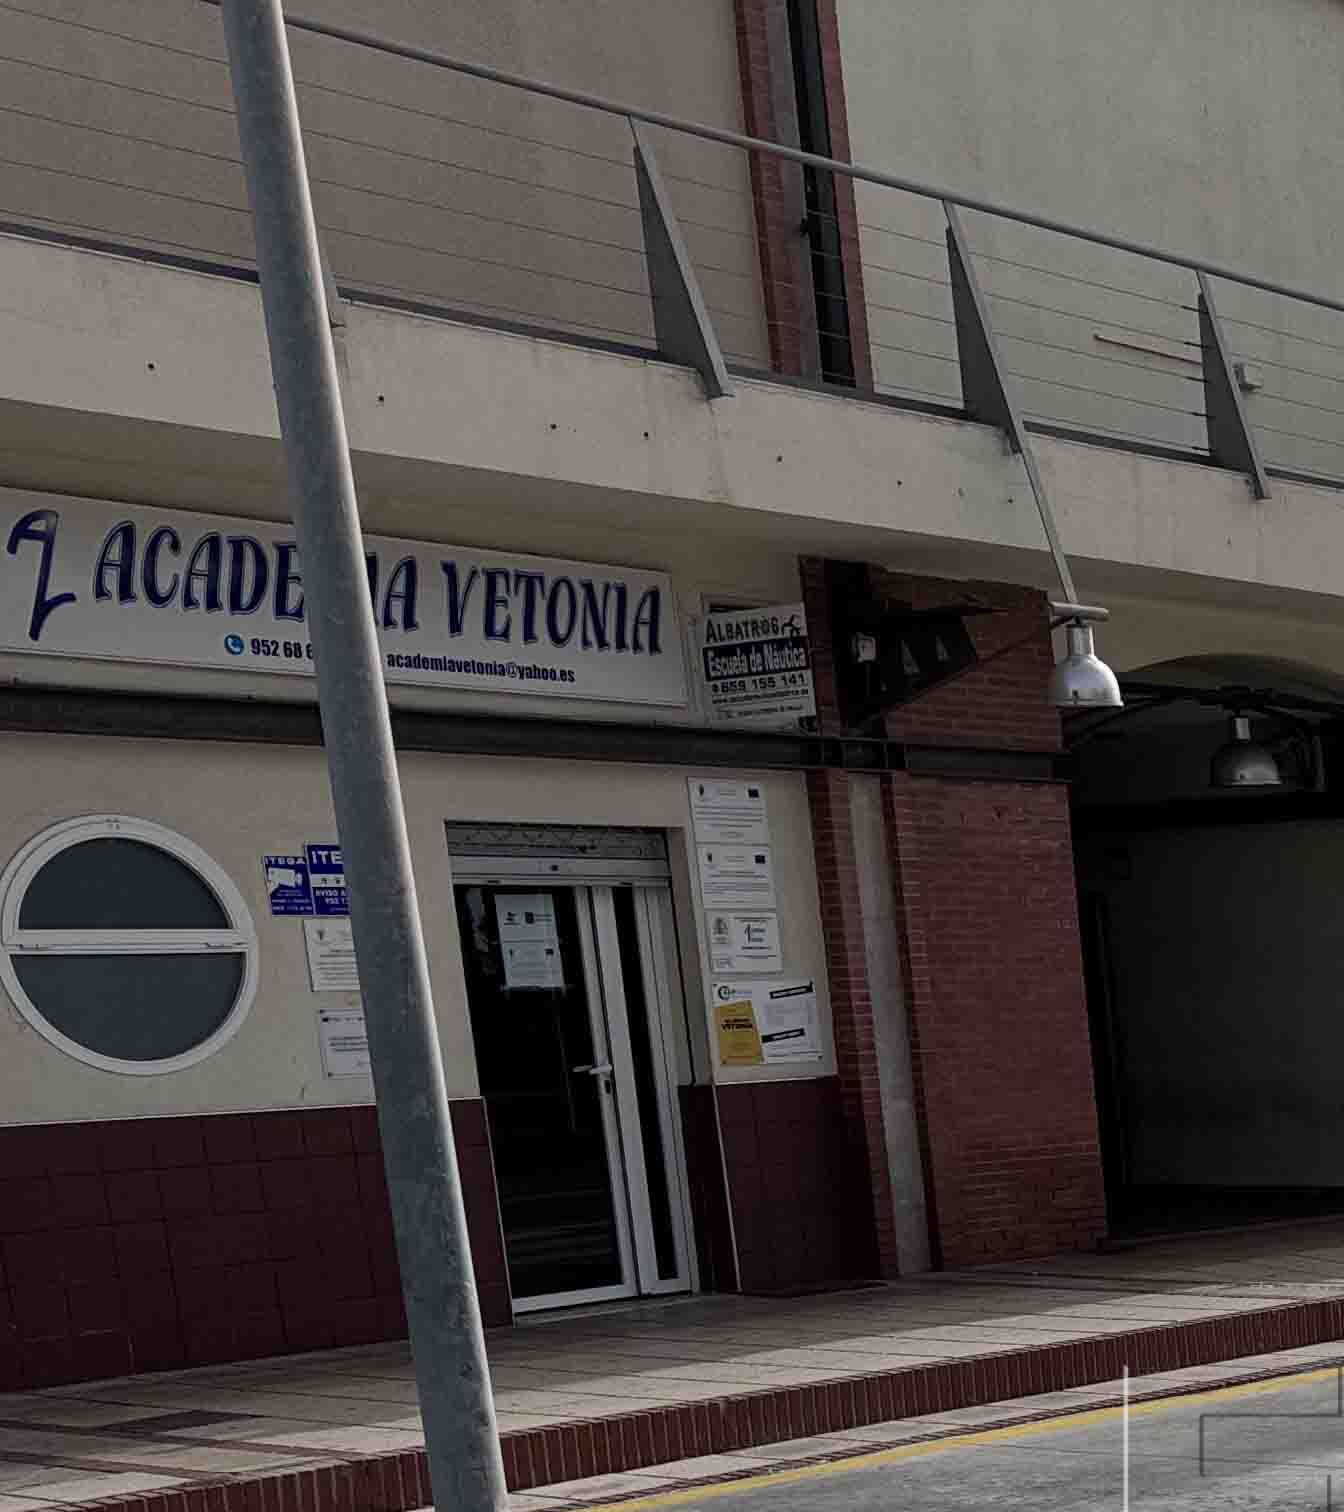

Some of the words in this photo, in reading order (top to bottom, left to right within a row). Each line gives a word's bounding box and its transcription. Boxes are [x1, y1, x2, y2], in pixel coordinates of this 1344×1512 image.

[441, 560, 663, 656] VETONIA
[251, 638, 280, 656] 952
[750, 644, 763, 673] de
[387, 653, 575, 682] academiavetonia@yahoo.es
[312, 850, 344, 865] ITE
